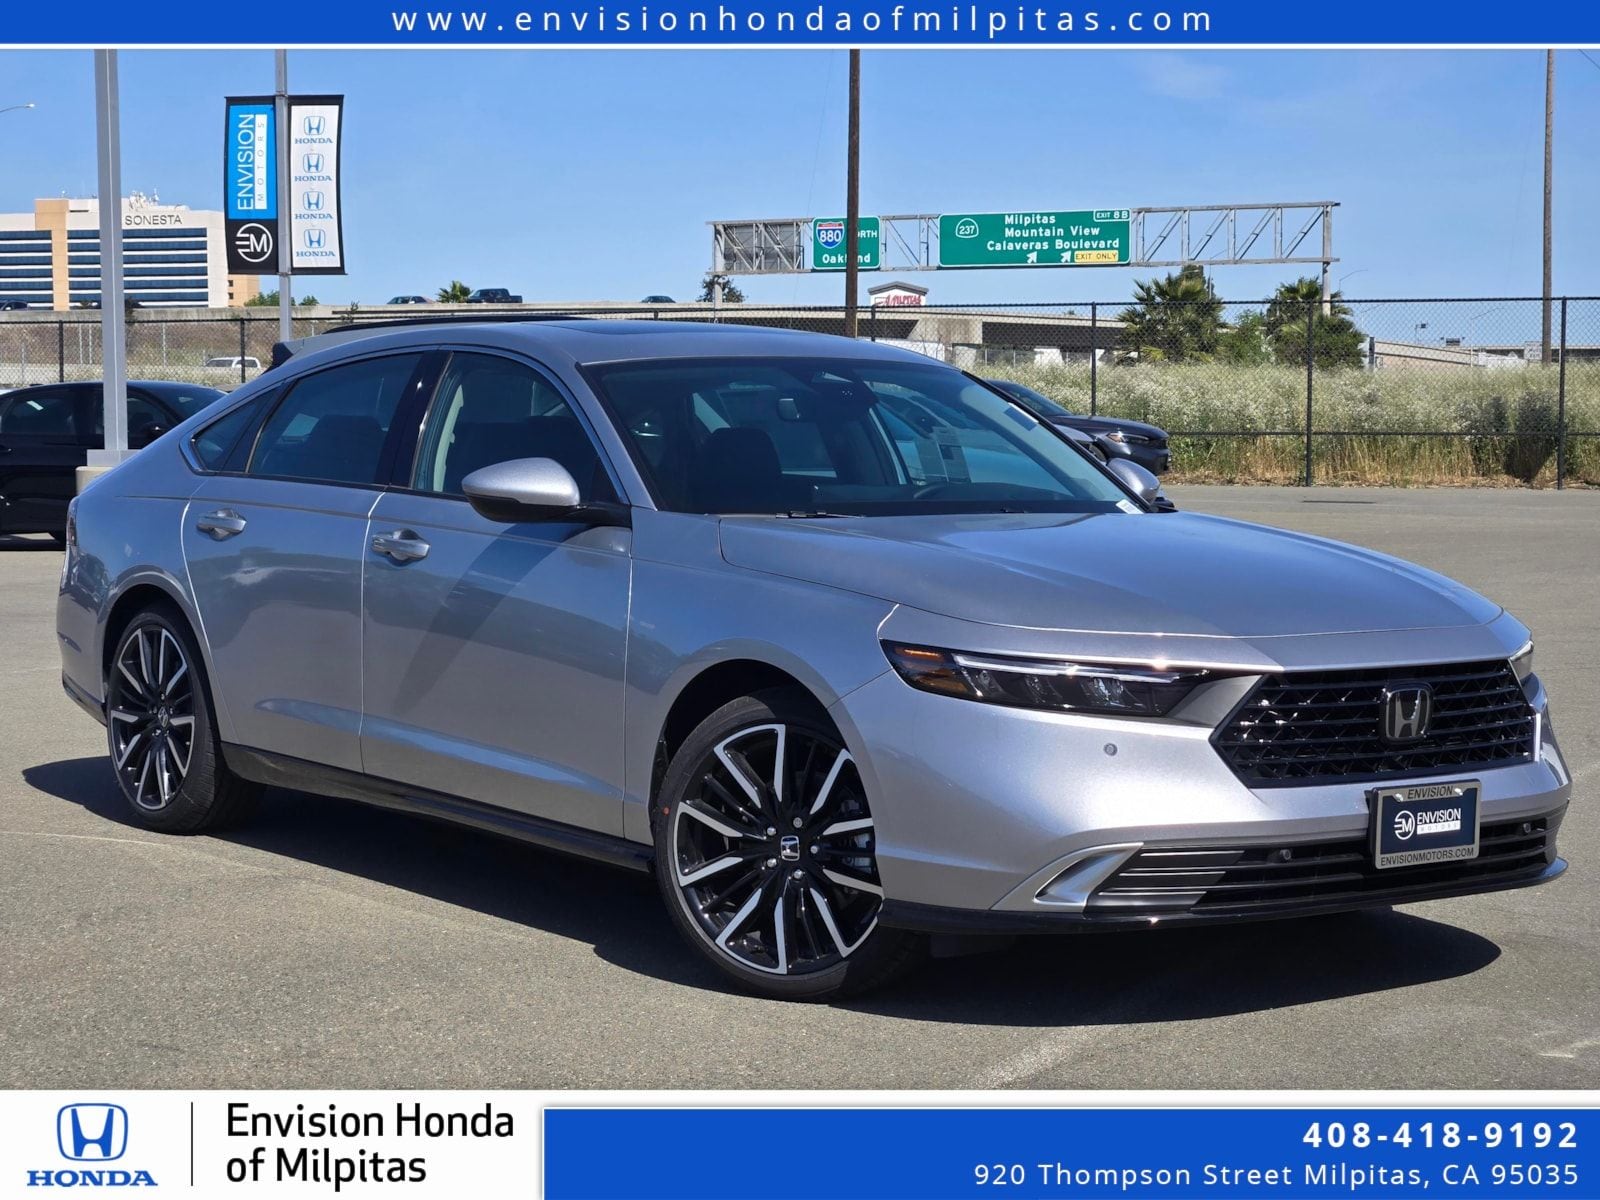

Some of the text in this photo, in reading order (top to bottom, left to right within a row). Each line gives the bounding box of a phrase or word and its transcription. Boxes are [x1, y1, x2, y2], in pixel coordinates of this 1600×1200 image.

[237, 113, 255, 210] ENVISION
[257, 121, 265, 202] MOTORS
[124, 214, 183, 226] SONESTA
[1004, 213, 1056, 226] Milpitas
[820, 230, 842, 242] 880
[959, 225, 975, 235] 237
[1004, 225, 1100, 238] Mountain View
[987, 238, 1120, 251] Calaveras Boulevard
[822, 253, 871, 264] Oaklnd
[1096, 252, 1117, 260] ONLY
[1407, 785, 1454, 799] ENVISION
[1417, 808, 1462, 825] ENVISION
[1381, 847, 1474, 866] ENVISIONMOTORS.COM
